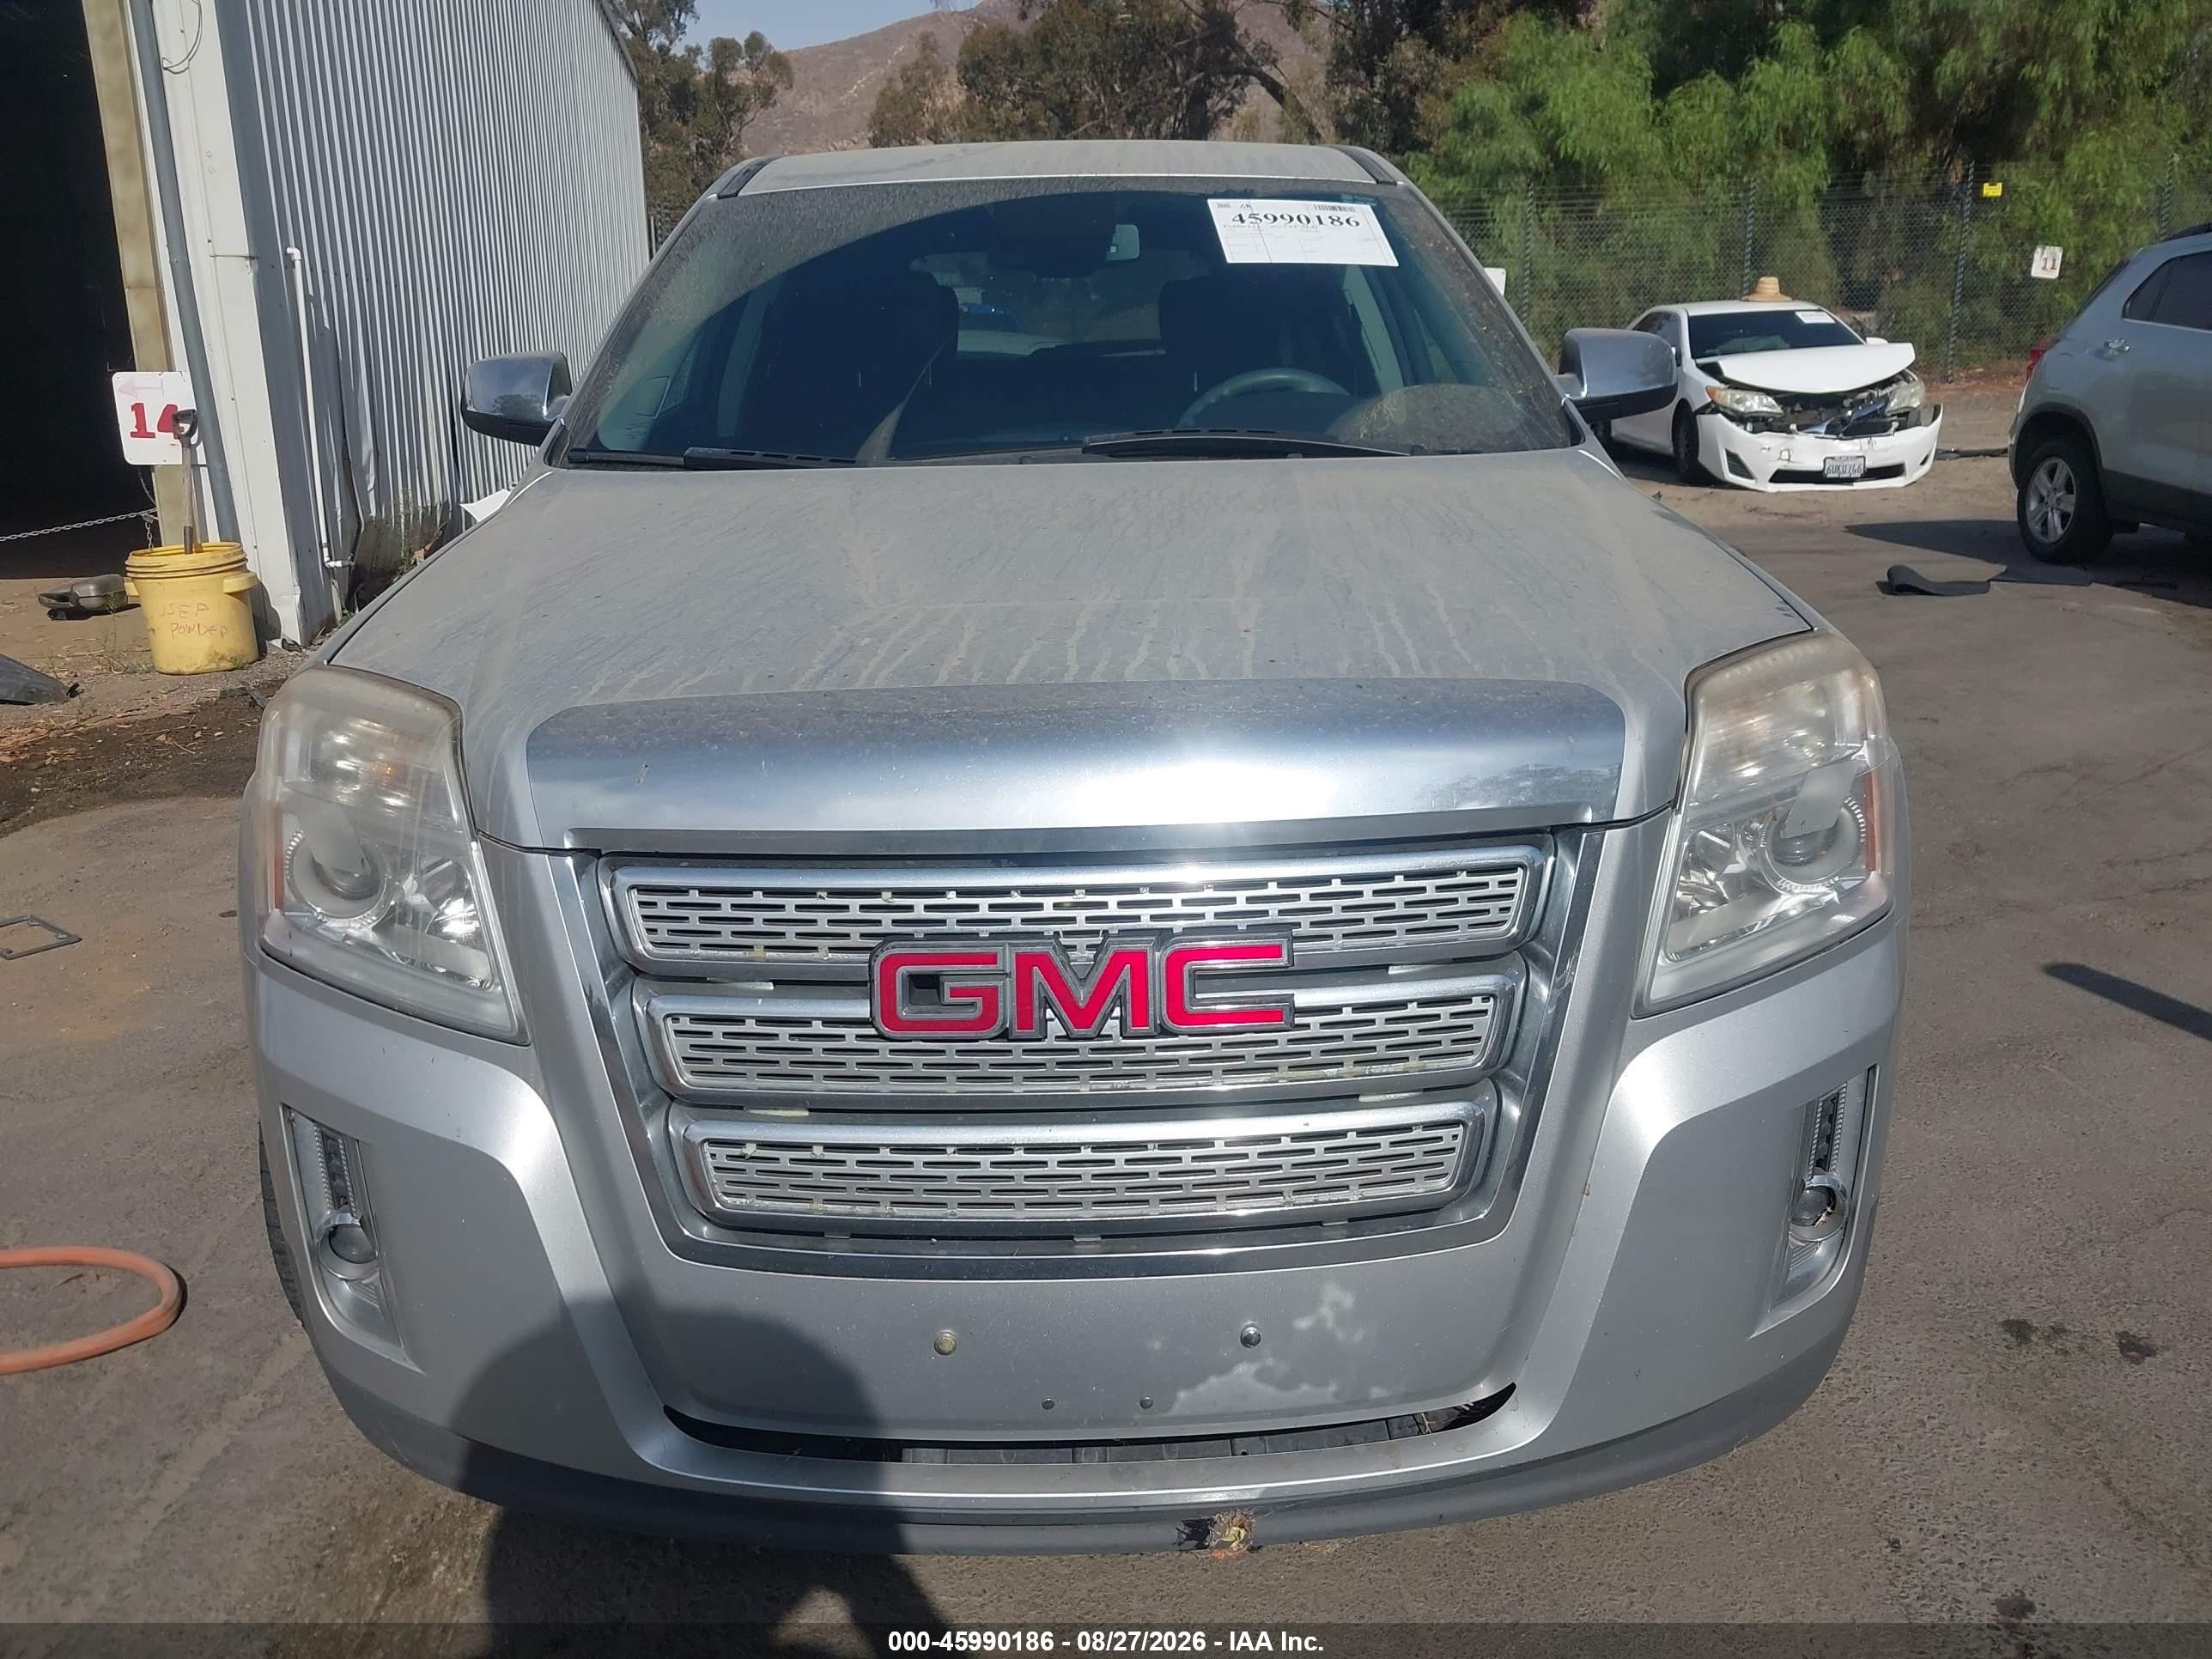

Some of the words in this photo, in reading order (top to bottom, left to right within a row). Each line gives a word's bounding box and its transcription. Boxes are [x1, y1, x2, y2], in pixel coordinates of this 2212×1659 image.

[1231, 212, 1361, 228] 45990186
[2041, 258, 2057, 270] 11
[871, 933, 1295, 1041] GMC
